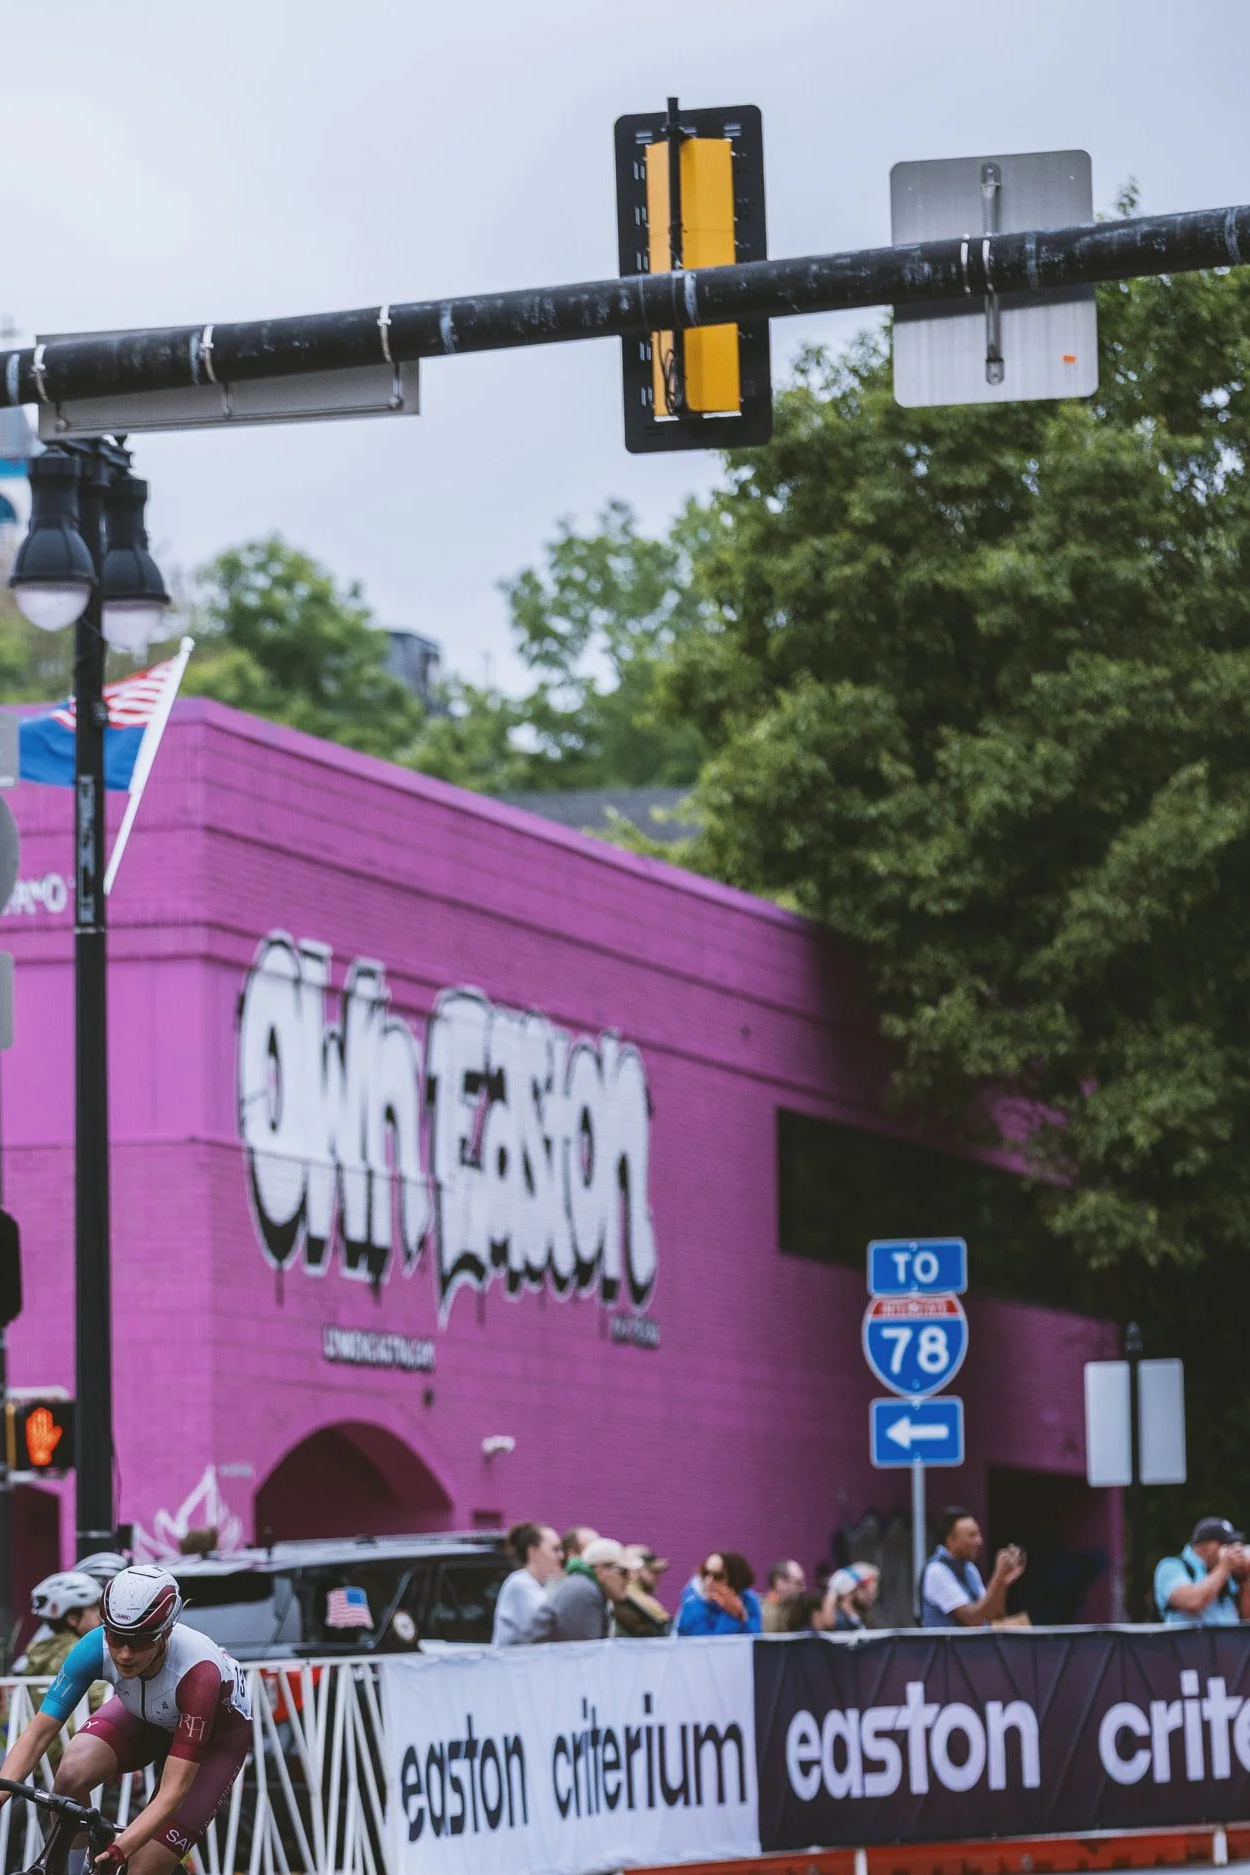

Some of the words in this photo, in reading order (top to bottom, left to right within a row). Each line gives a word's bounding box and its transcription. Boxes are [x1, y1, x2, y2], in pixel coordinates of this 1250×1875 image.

[891, 1251, 939, 1284] TO
[881, 1325, 950, 1375] 78
[401, 1712, 528, 1842] easton
[553, 1693, 748, 1819] criterium
[785, 1681, 1041, 1801] easton
